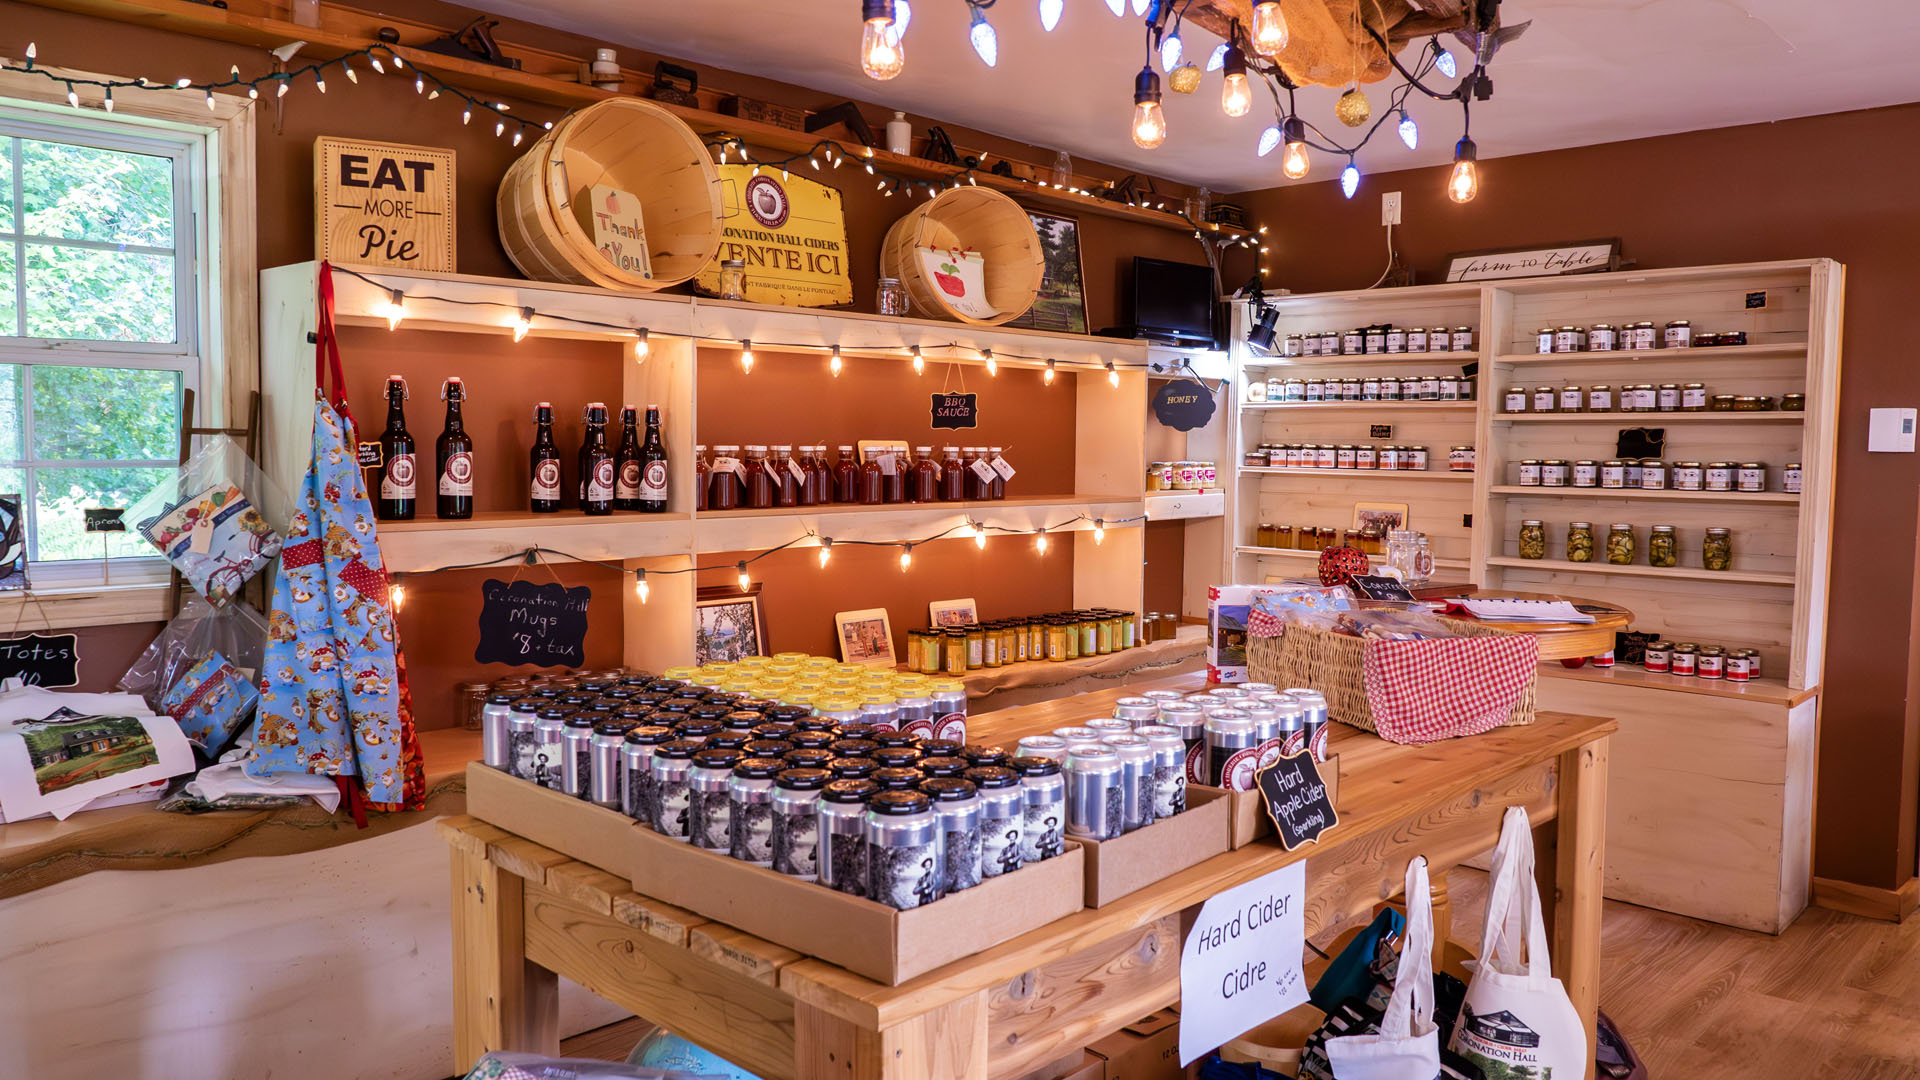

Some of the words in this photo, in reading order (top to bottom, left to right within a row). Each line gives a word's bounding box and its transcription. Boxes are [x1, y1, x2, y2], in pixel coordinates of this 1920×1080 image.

[340, 154, 434, 192] EAT
[364, 199, 413, 218] MORE
[596, 212, 644, 241] Thank
[722, 228, 774, 242] ONATION
[777, 234, 802, 246] HALL
[804, 238, 840, 251] CIDERS
[358, 224, 419, 261] Pie
[611, 241, 650, 279] You!
[806, 252, 840, 276] ICI
[1452, 260, 1512, 282] farm
[1520, 258, 1538, 268] TO
[937, 408, 970, 416] SAUCE
[944, 398, 966, 408] BBQ
[1167, 395, 1198, 404] HONEY
[488, 588, 558, 607] Coronation
[510, 608, 557, 638] Mugs
[0, 644, 69, 661] Totes
[548, 640, 574, 656] tax
[1274, 762, 1304, 792] Hard
[1274, 794, 1303, 826] Apple
[1300, 782, 1324, 806] Cider
[1292, 808, 1325, 838] (sparkling)
[1198, 910, 1241, 954] Hard
[1247, 894, 1291, 930] Cider
[1222, 961, 1267, 999] Cidre
[1458, 1029, 1510, 1058] CORONATION
[1513, 1051, 1538, 1062] HALL
